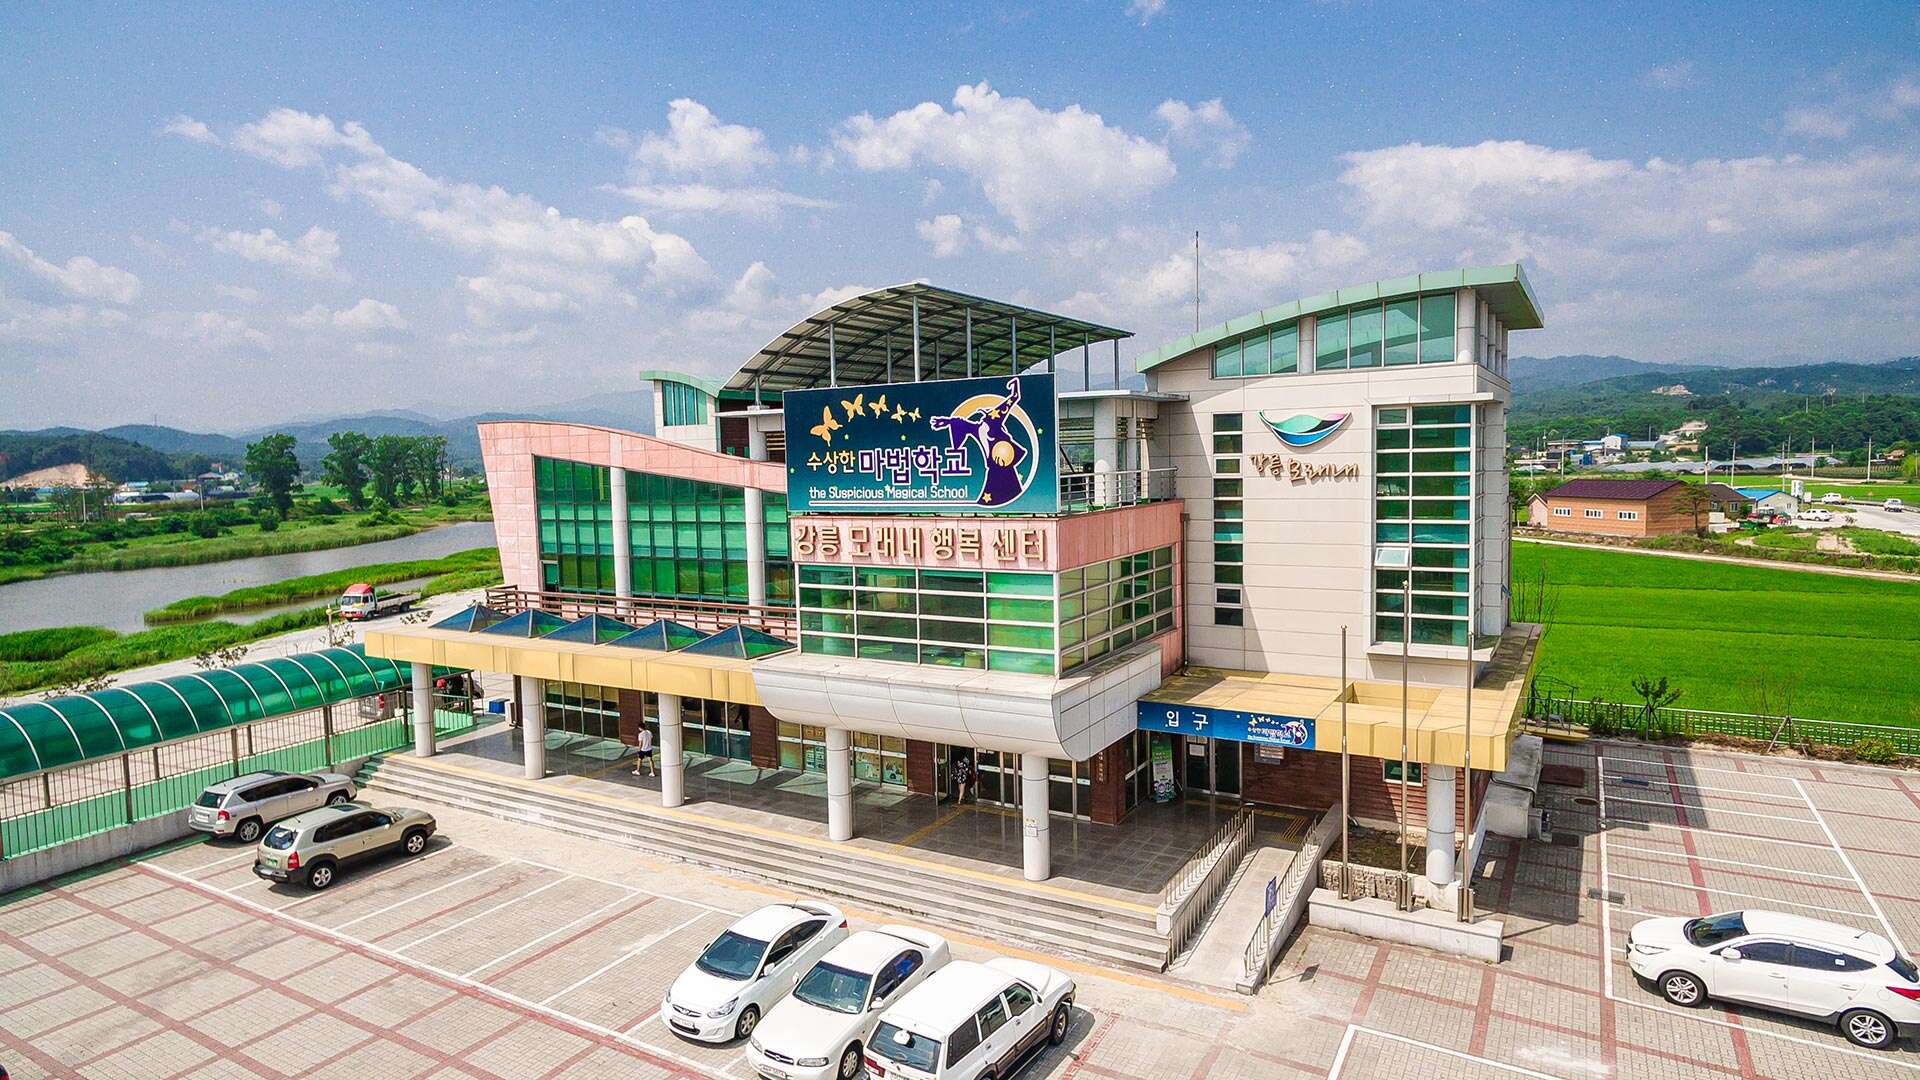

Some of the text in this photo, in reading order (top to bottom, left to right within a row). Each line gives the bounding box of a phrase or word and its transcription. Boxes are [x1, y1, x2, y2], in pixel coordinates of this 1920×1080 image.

[806, 445, 972, 486] 수상한 마법학교
[1251, 453, 1281, 475] 강릉
[808, 485, 968, 500] the Suspicious Magical School
[795, 525, 1046, 562] 강릉 모래내 행복 센터
